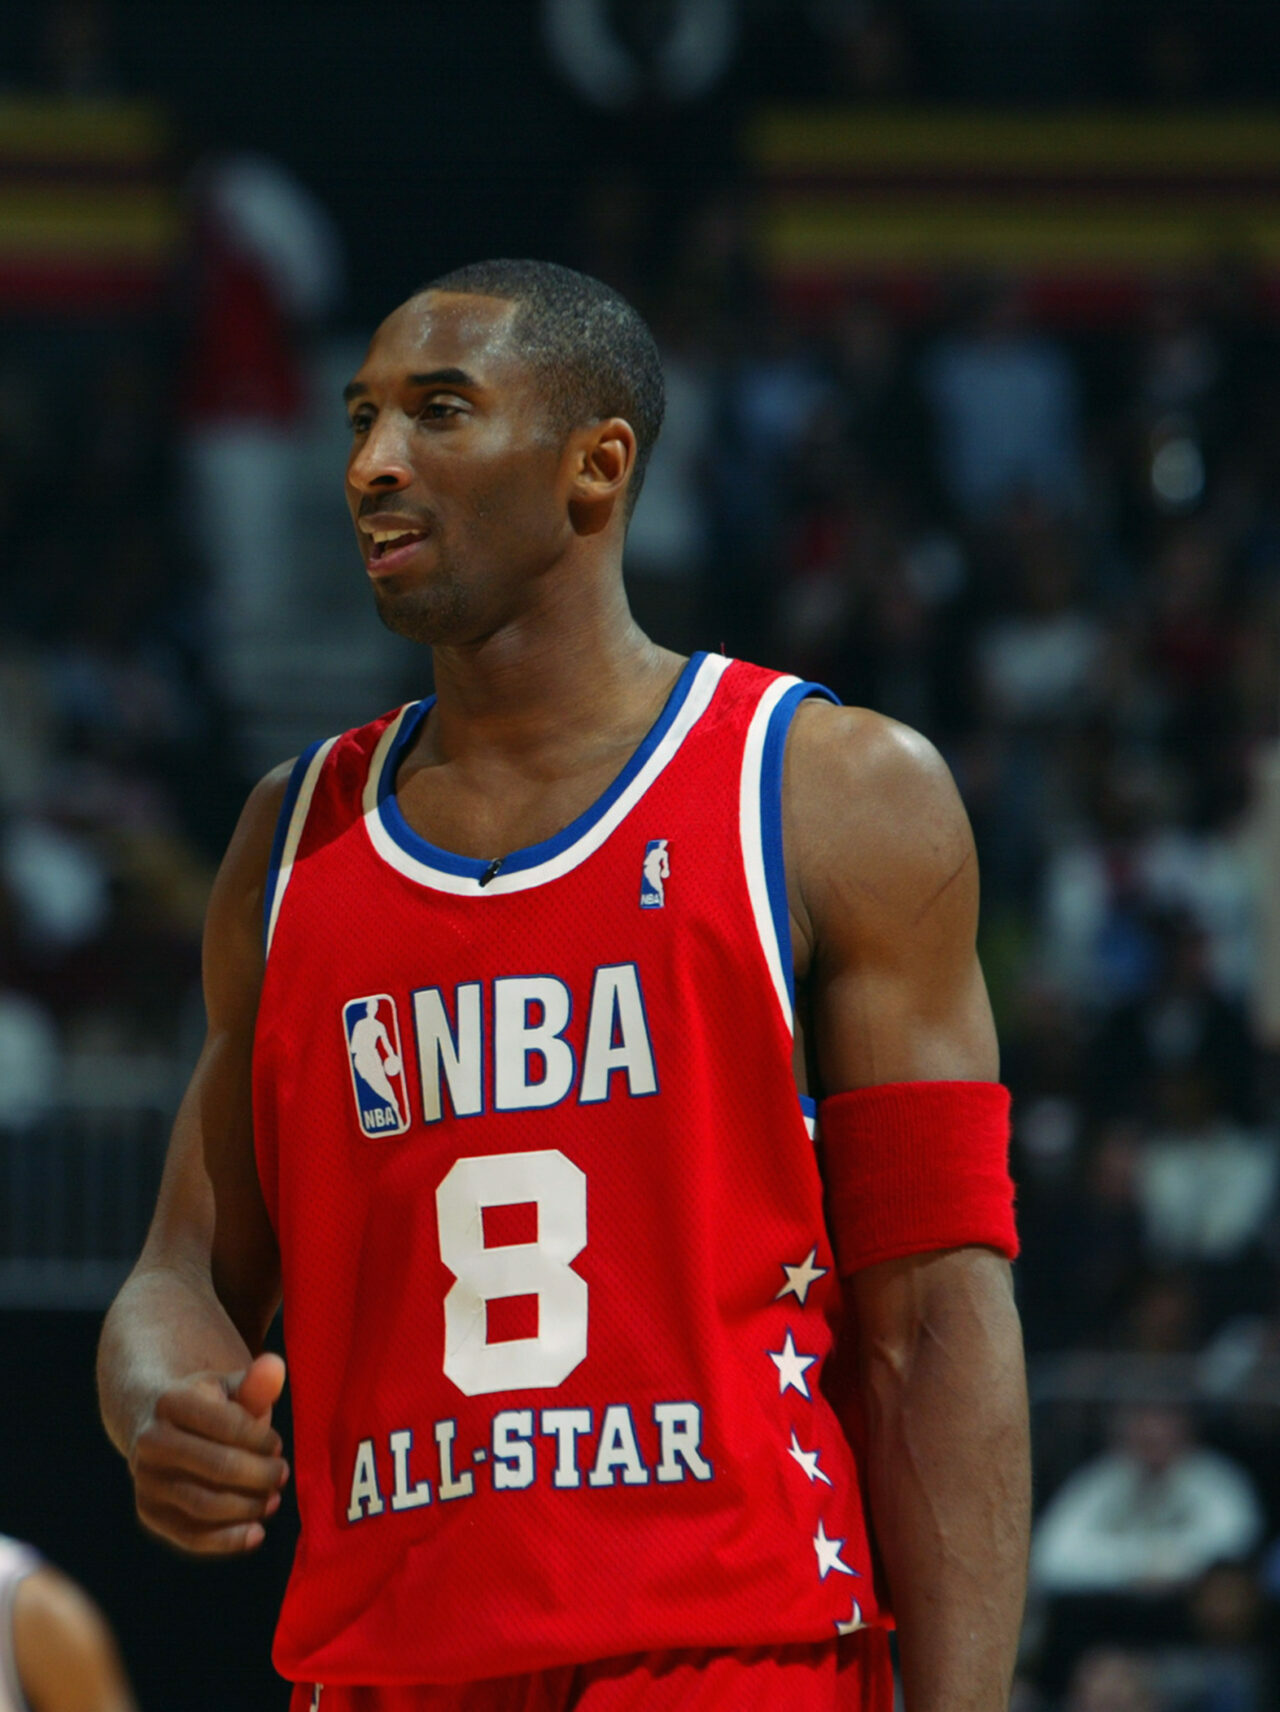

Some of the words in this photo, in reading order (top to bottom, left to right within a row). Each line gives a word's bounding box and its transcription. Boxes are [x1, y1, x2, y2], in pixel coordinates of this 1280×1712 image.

[641, 893, 660, 905] NBA
[410, 961, 660, 1126] NBA
[363, 1106, 397, 1129] NBA
[435, 1148, 589, 1397] 8
[346, 1401, 715, 1523] ALL-STAR
